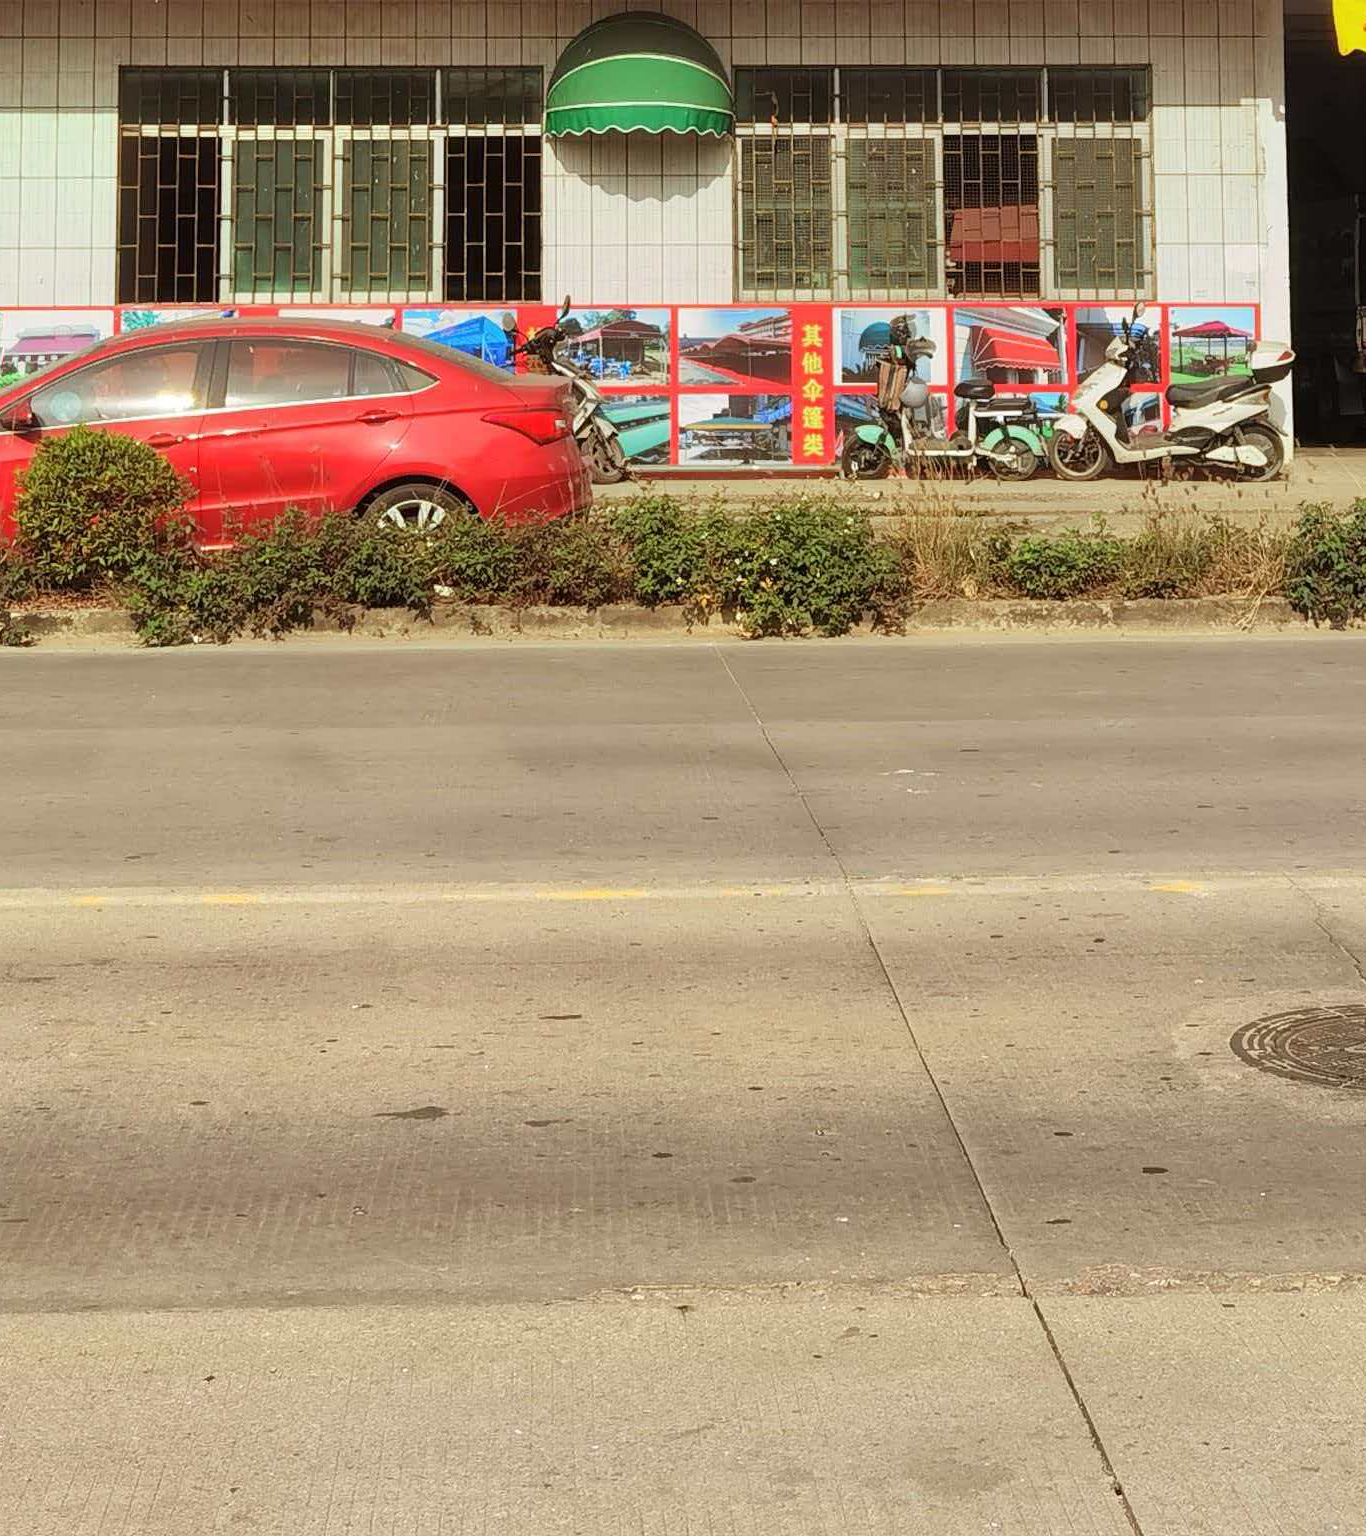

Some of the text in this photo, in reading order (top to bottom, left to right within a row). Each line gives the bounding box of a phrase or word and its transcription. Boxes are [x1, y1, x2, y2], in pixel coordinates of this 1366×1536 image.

[801, 324, 824, 457] 其他伞篷类
